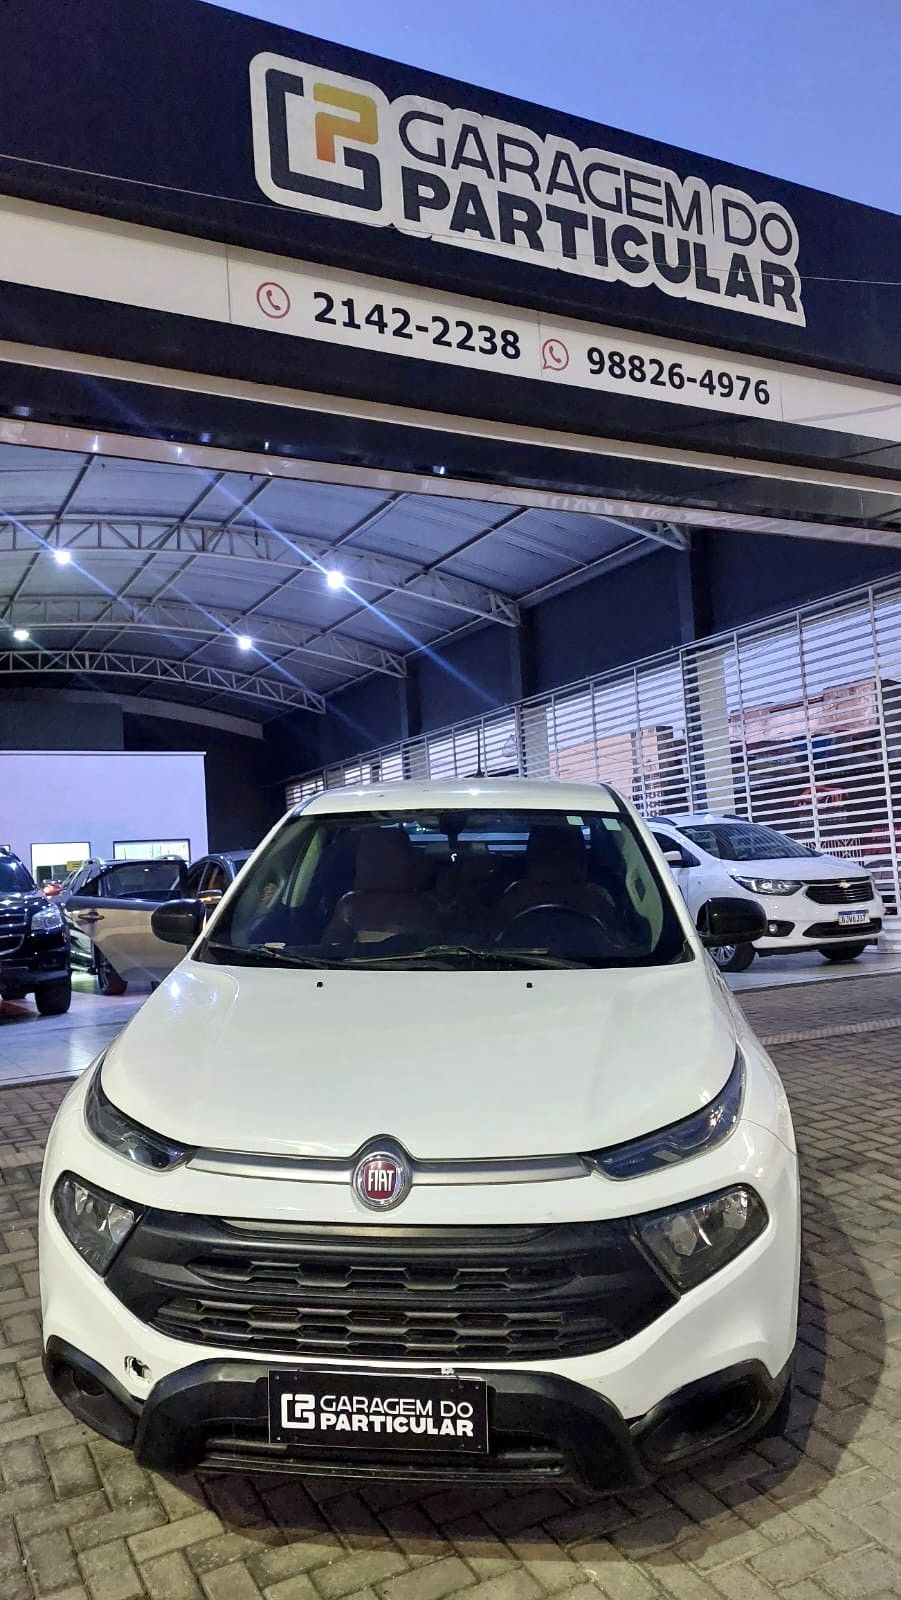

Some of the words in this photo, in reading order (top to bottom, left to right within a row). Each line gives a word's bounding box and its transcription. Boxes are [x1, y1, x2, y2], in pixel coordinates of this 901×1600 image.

[398, 109, 704, 236] GARAGEM
[722, 197, 793, 256] DO
[402, 166, 797, 313] PARTICULAR
[313, 291, 521, 360] 2142-2238
[586, 346, 770, 405] 98826-4976
[367, 1169, 394, 1192] FIAT
[319, 1394, 433, 1417] GARAGEM
[440, 1400, 475, 1419] DO
[319, 1412, 475, 1437] PARTICULAR
